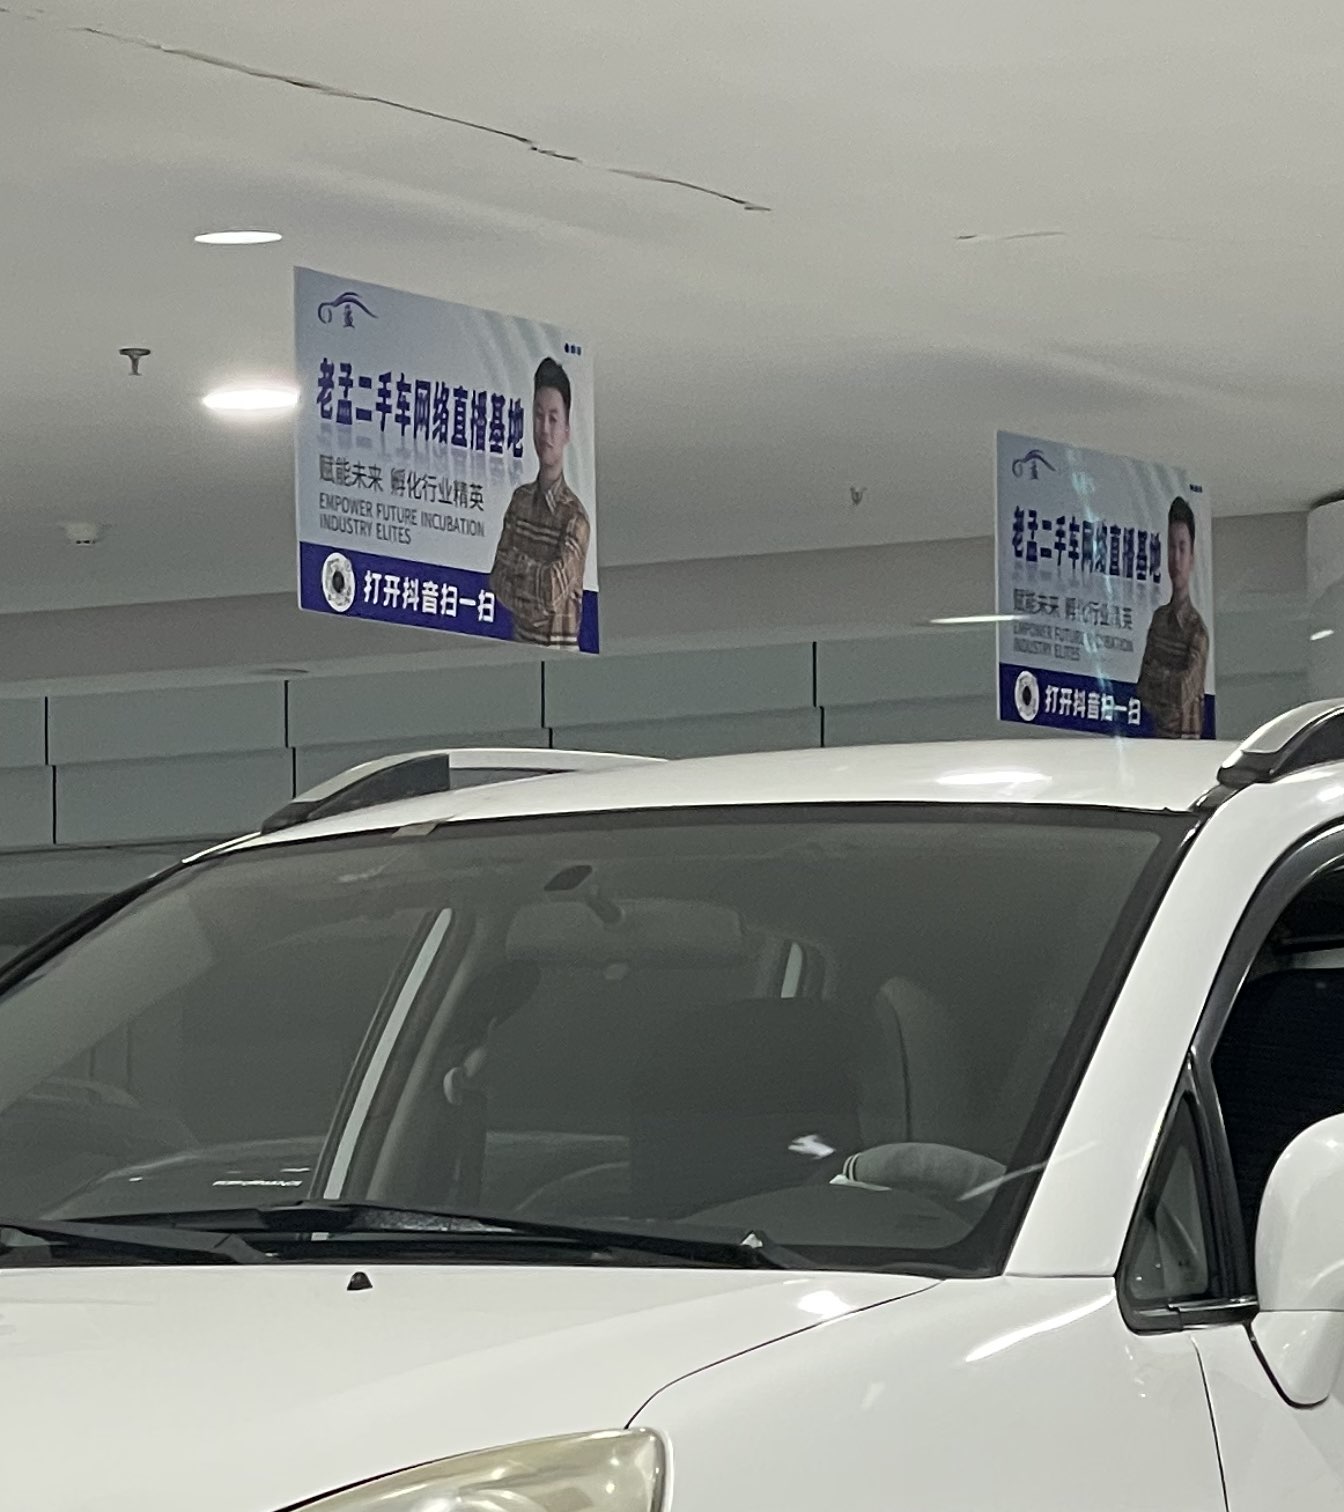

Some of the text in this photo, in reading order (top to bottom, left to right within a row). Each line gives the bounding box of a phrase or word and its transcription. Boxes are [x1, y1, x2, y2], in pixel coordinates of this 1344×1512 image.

[317, 357, 525, 459] 老孟二手车网络直播基地
[319, 492, 486, 538] EMPOWER FUTURE INCUBATION
[319, 513, 412, 545] INDUSTRY ELITES
[363, 570, 496, 623] 打开抖音扫一扫
